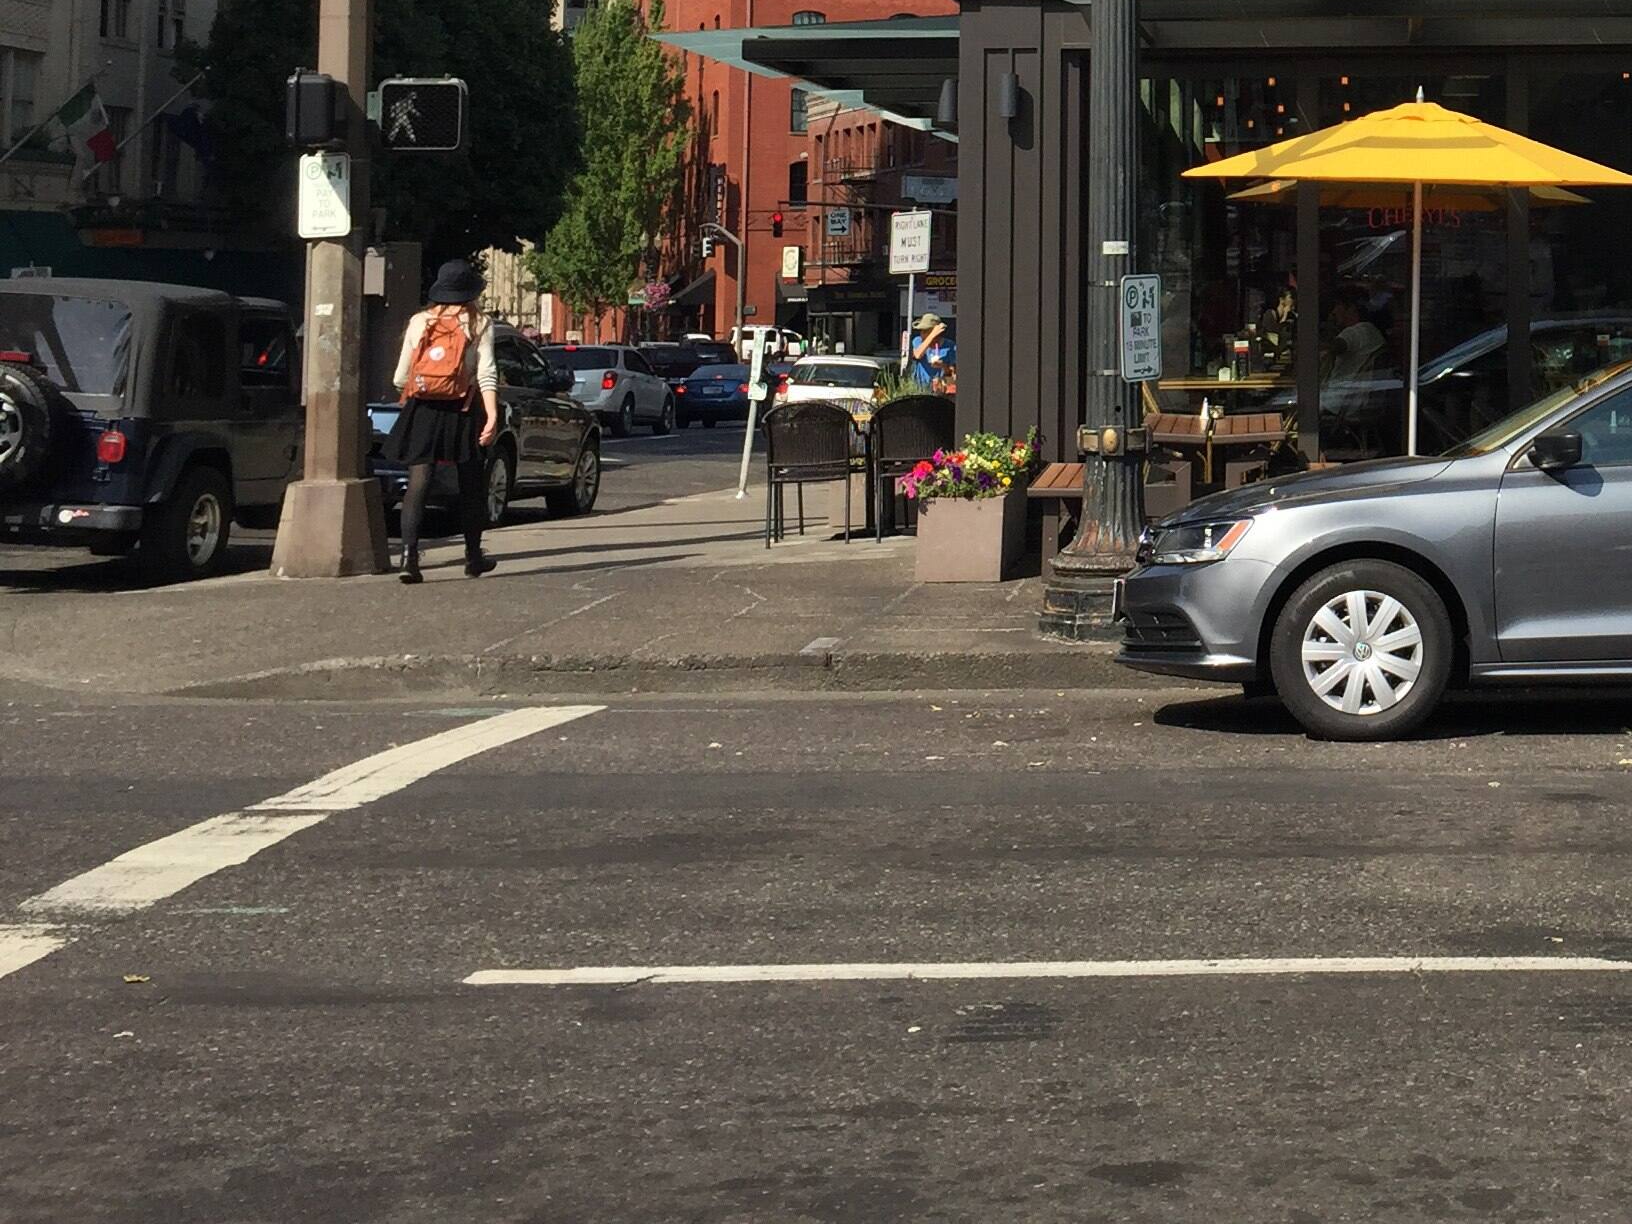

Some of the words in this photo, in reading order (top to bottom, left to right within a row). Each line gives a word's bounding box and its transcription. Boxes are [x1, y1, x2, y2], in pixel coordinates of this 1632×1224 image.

[312, 209, 336, 218] PARK
[901, 236, 921, 247] MUST
[893, 255, 909, 264] TURN
[911, 254, 928, 263] RIGHT
[1133, 327, 1150, 336] PARK
[1134, 338, 1157, 350] MINUTE
